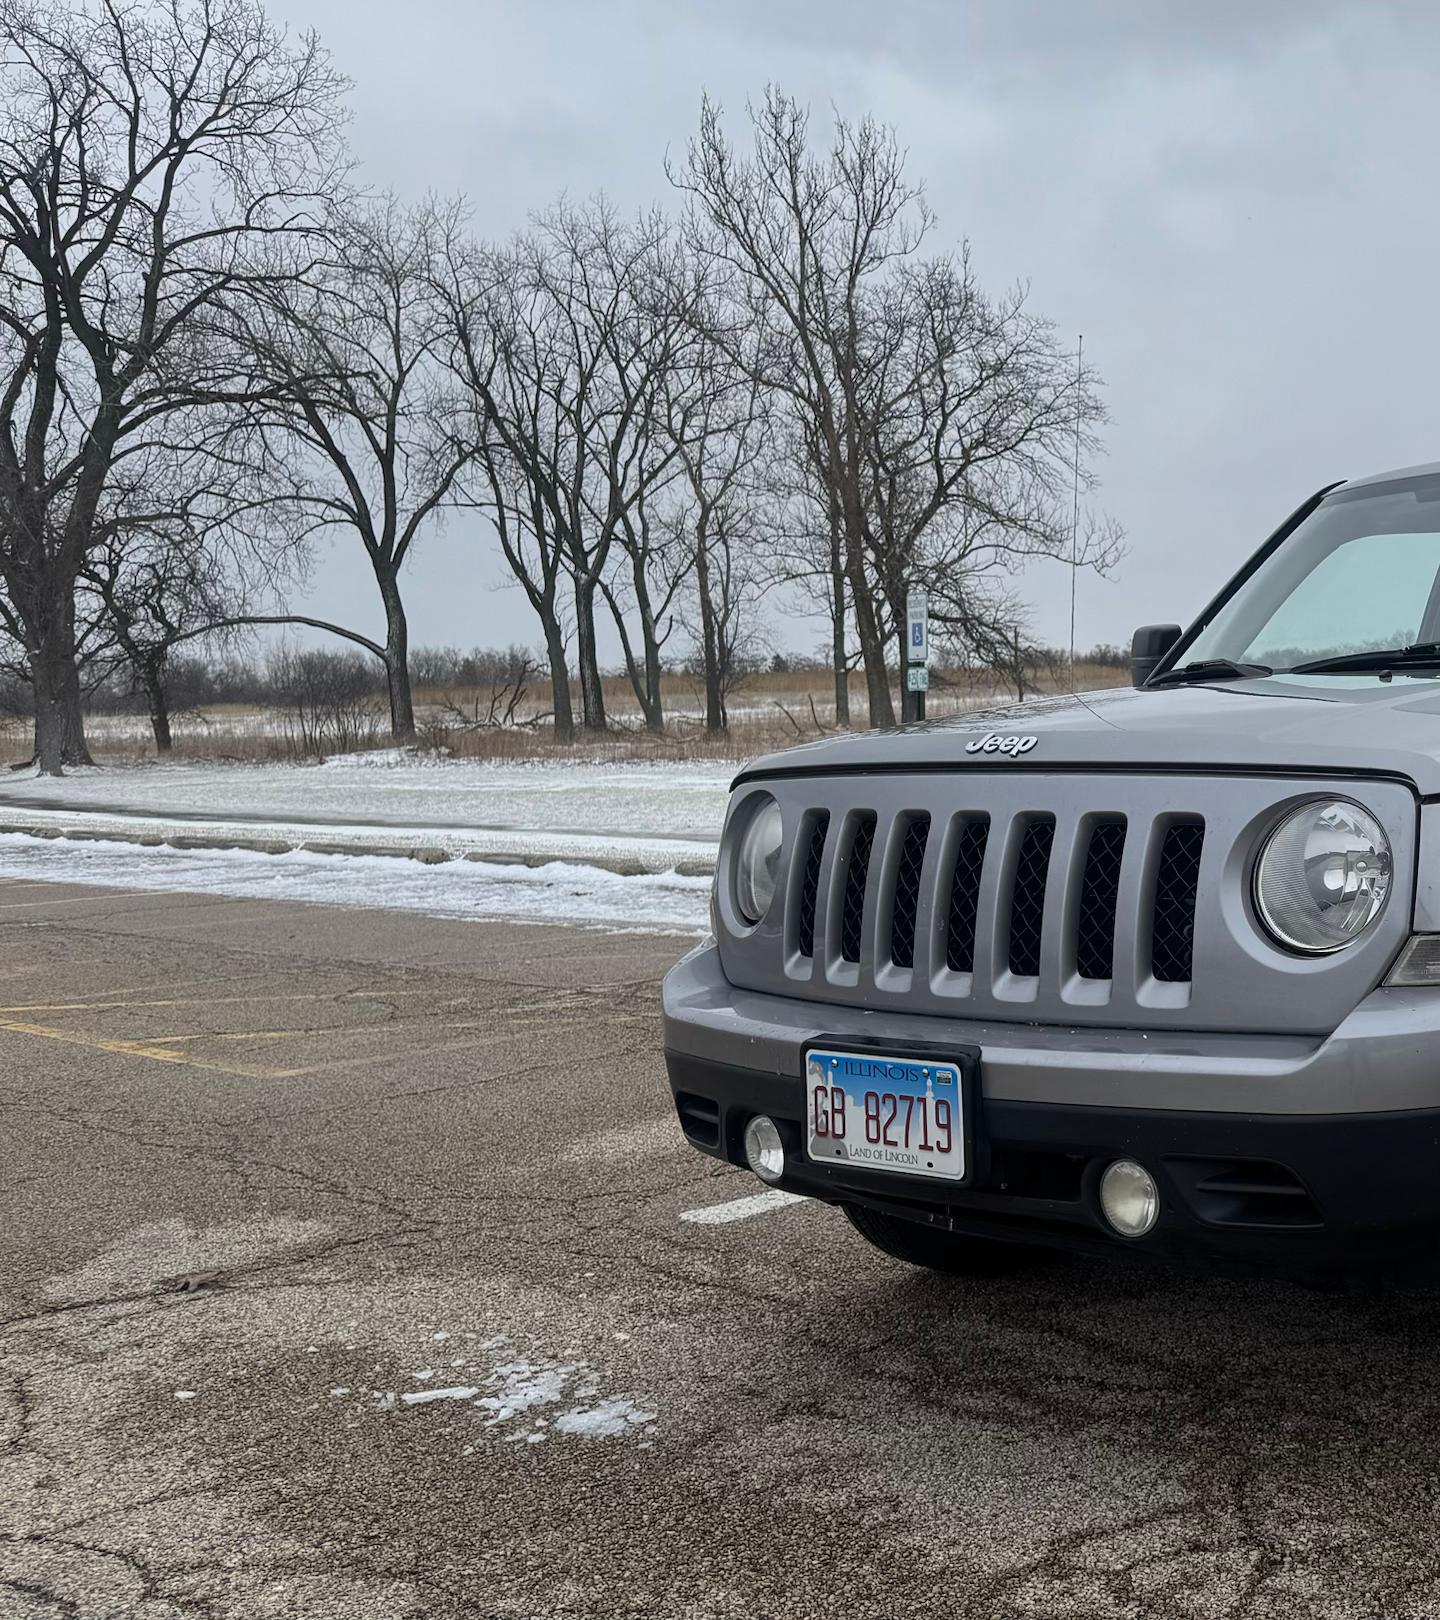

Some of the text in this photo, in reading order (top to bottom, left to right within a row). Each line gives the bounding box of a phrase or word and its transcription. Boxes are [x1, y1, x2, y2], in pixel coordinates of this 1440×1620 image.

[965, 732, 1038, 758] Jeep
[844, 1061, 919, 1082] ILLINOIS
[814, 1085, 952, 1153] GB 82719
